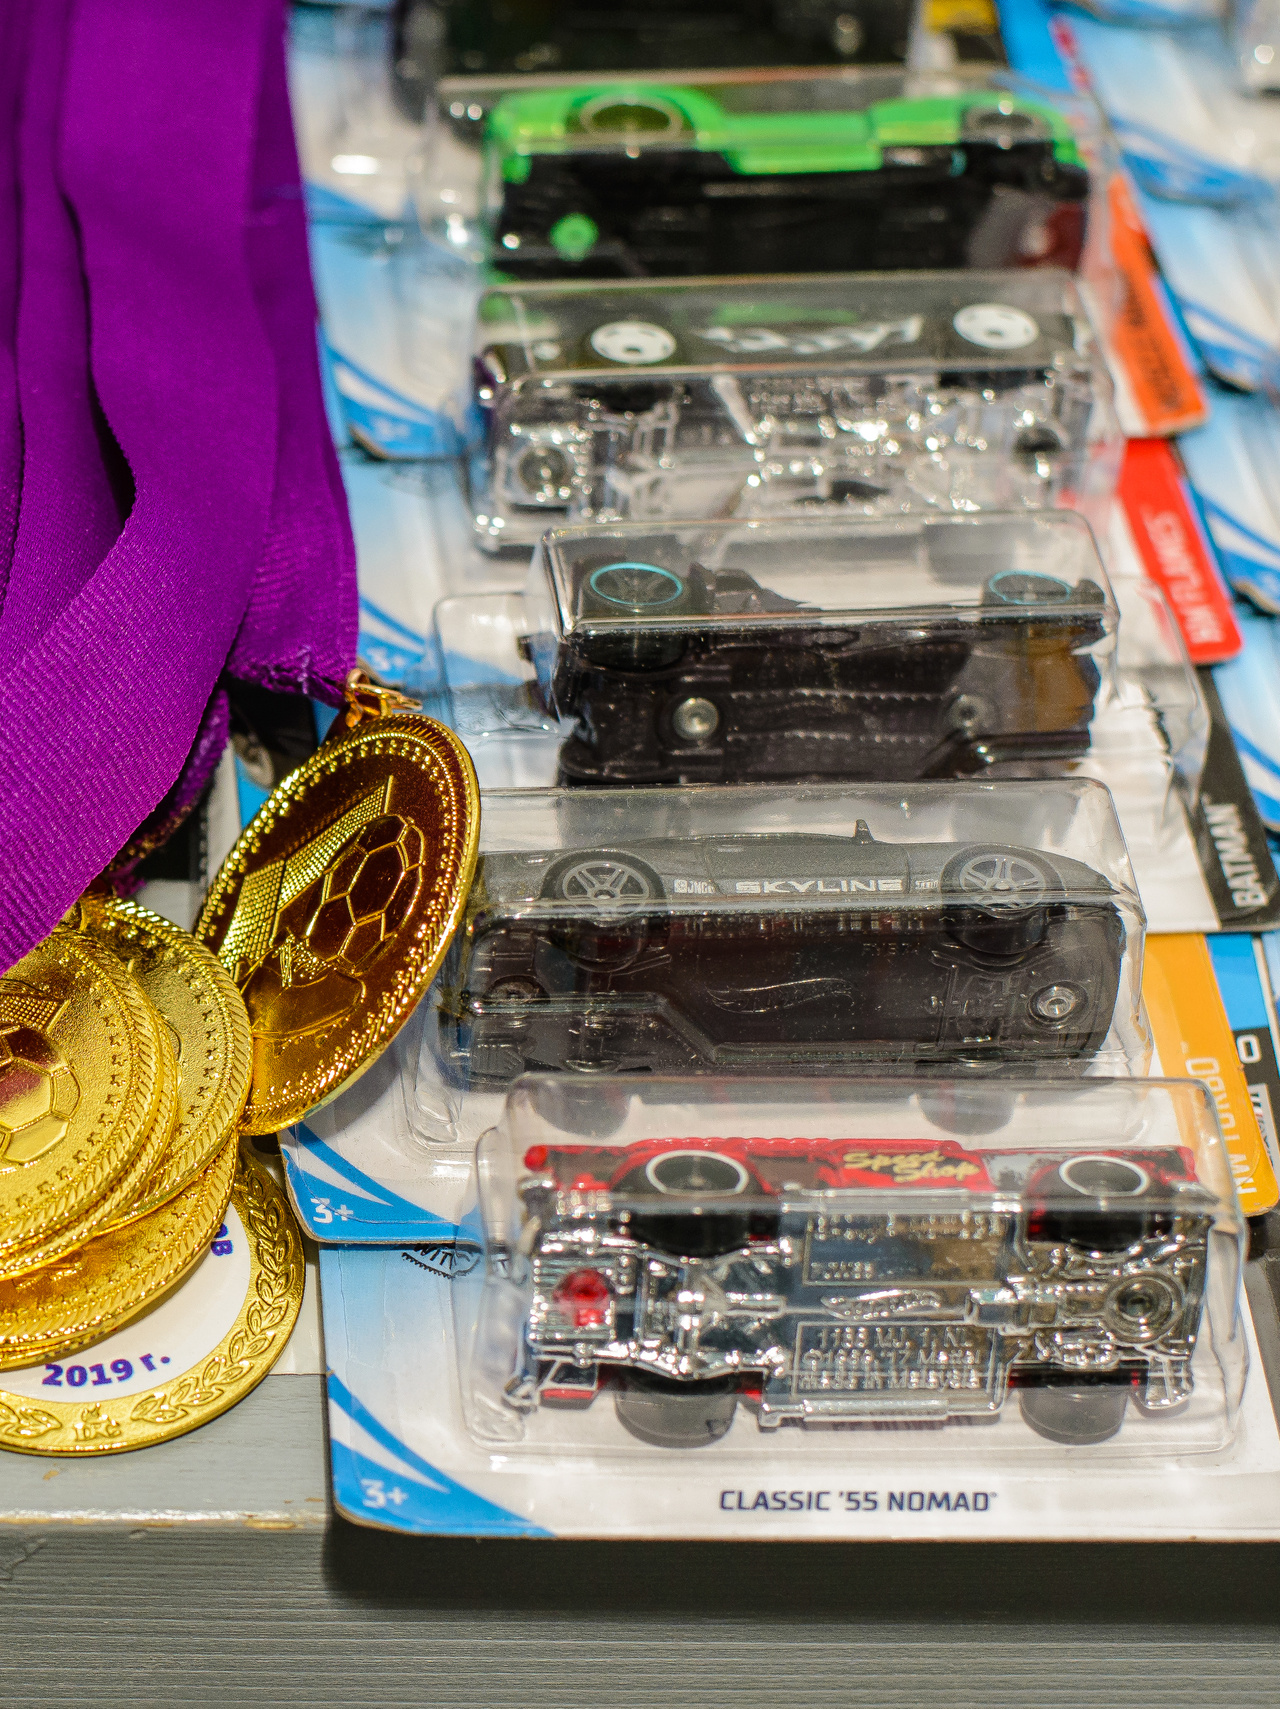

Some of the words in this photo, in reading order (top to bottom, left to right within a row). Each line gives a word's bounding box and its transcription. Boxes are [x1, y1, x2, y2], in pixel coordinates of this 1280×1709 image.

[1205, 802, 1269, 908] BATMAN
[735, 879, 904, 894] SKYLINE
[310, 1197, 354, 1224] 3+
[41, 1358, 134, 1388] 2019
[139, 1352, 171, 1373] г.
[361, 1478, 409, 1509] 3+
[720, 1490, 831, 1511] CLASSIC
[838, 1491, 879, 1511] '55
[886, 1491, 990, 1512] NOMAD
